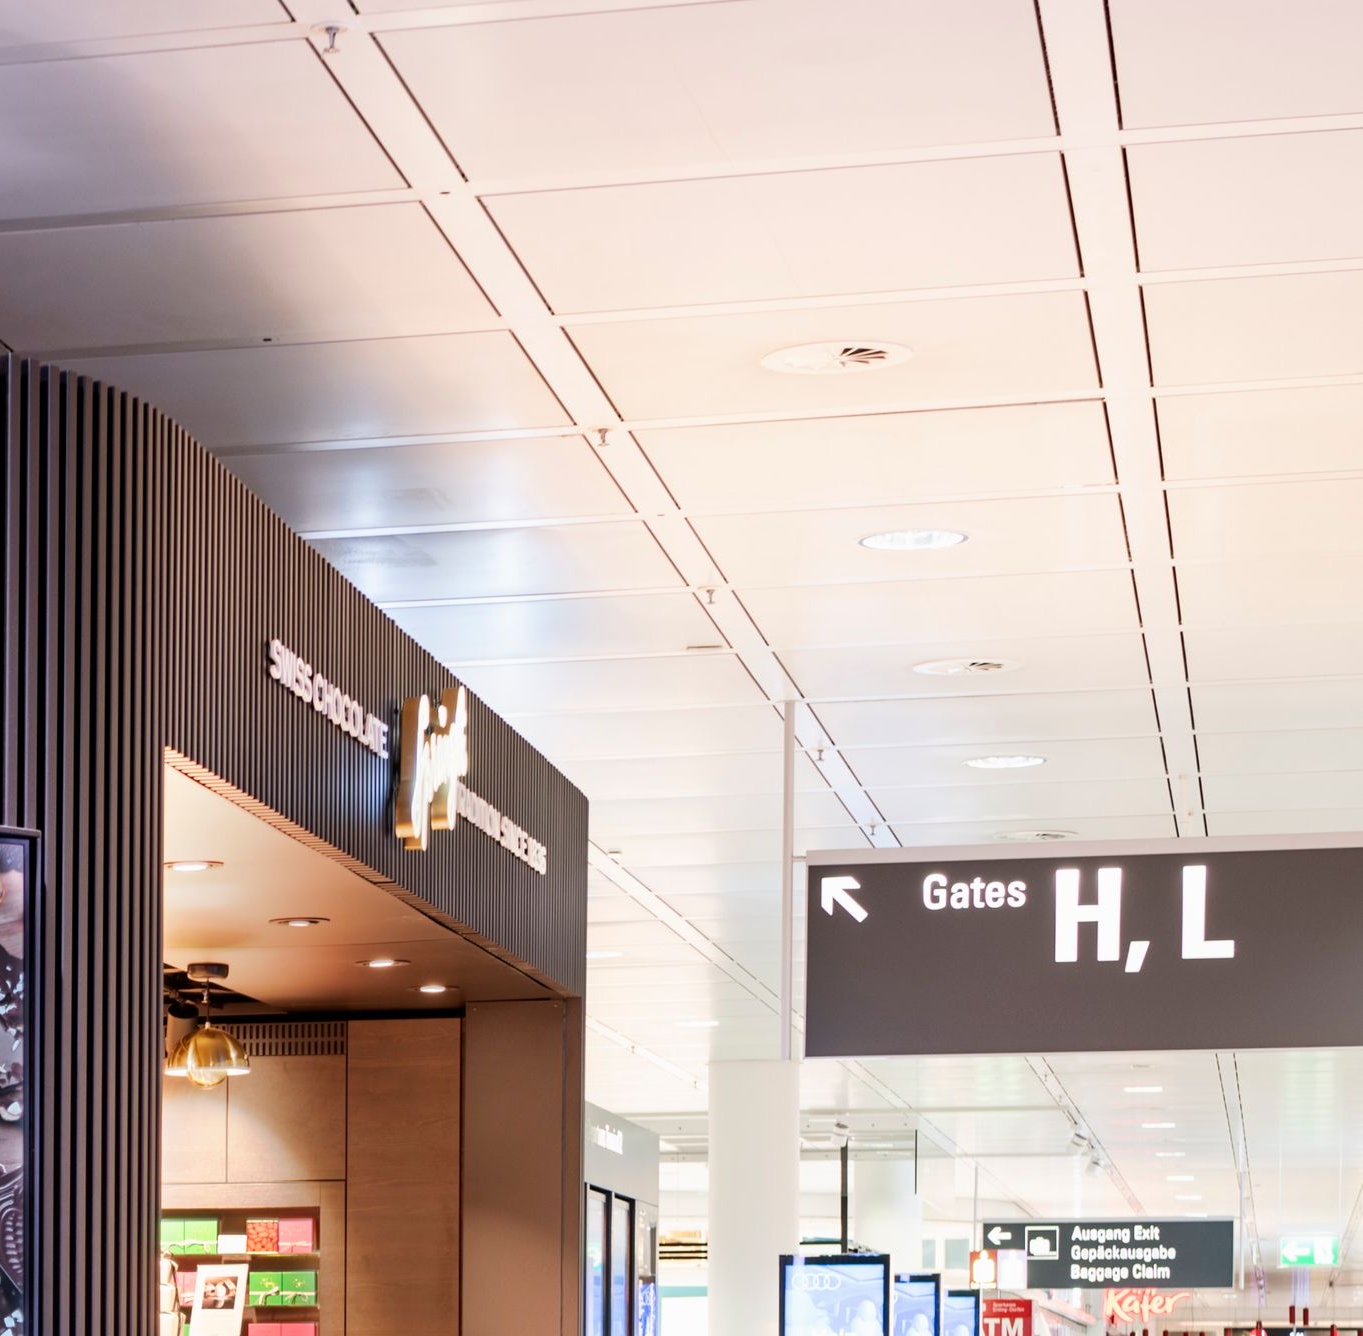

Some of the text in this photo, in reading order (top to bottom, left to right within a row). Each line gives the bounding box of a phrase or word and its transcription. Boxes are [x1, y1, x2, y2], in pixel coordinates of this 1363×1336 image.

[269, 638, 388, 759] SWISS CHOCOLATE
[923, 865, 1235, 973] Gates H, L
[1071, 1225, 1161, 1243] Ausgang Exit
[1070, 1245, 1177, 1262] Gepäckausgabe
[1070, 1263, 1171, 1282] Baggage Claim
[1104, 1287, 1191, 1323] Käfer
